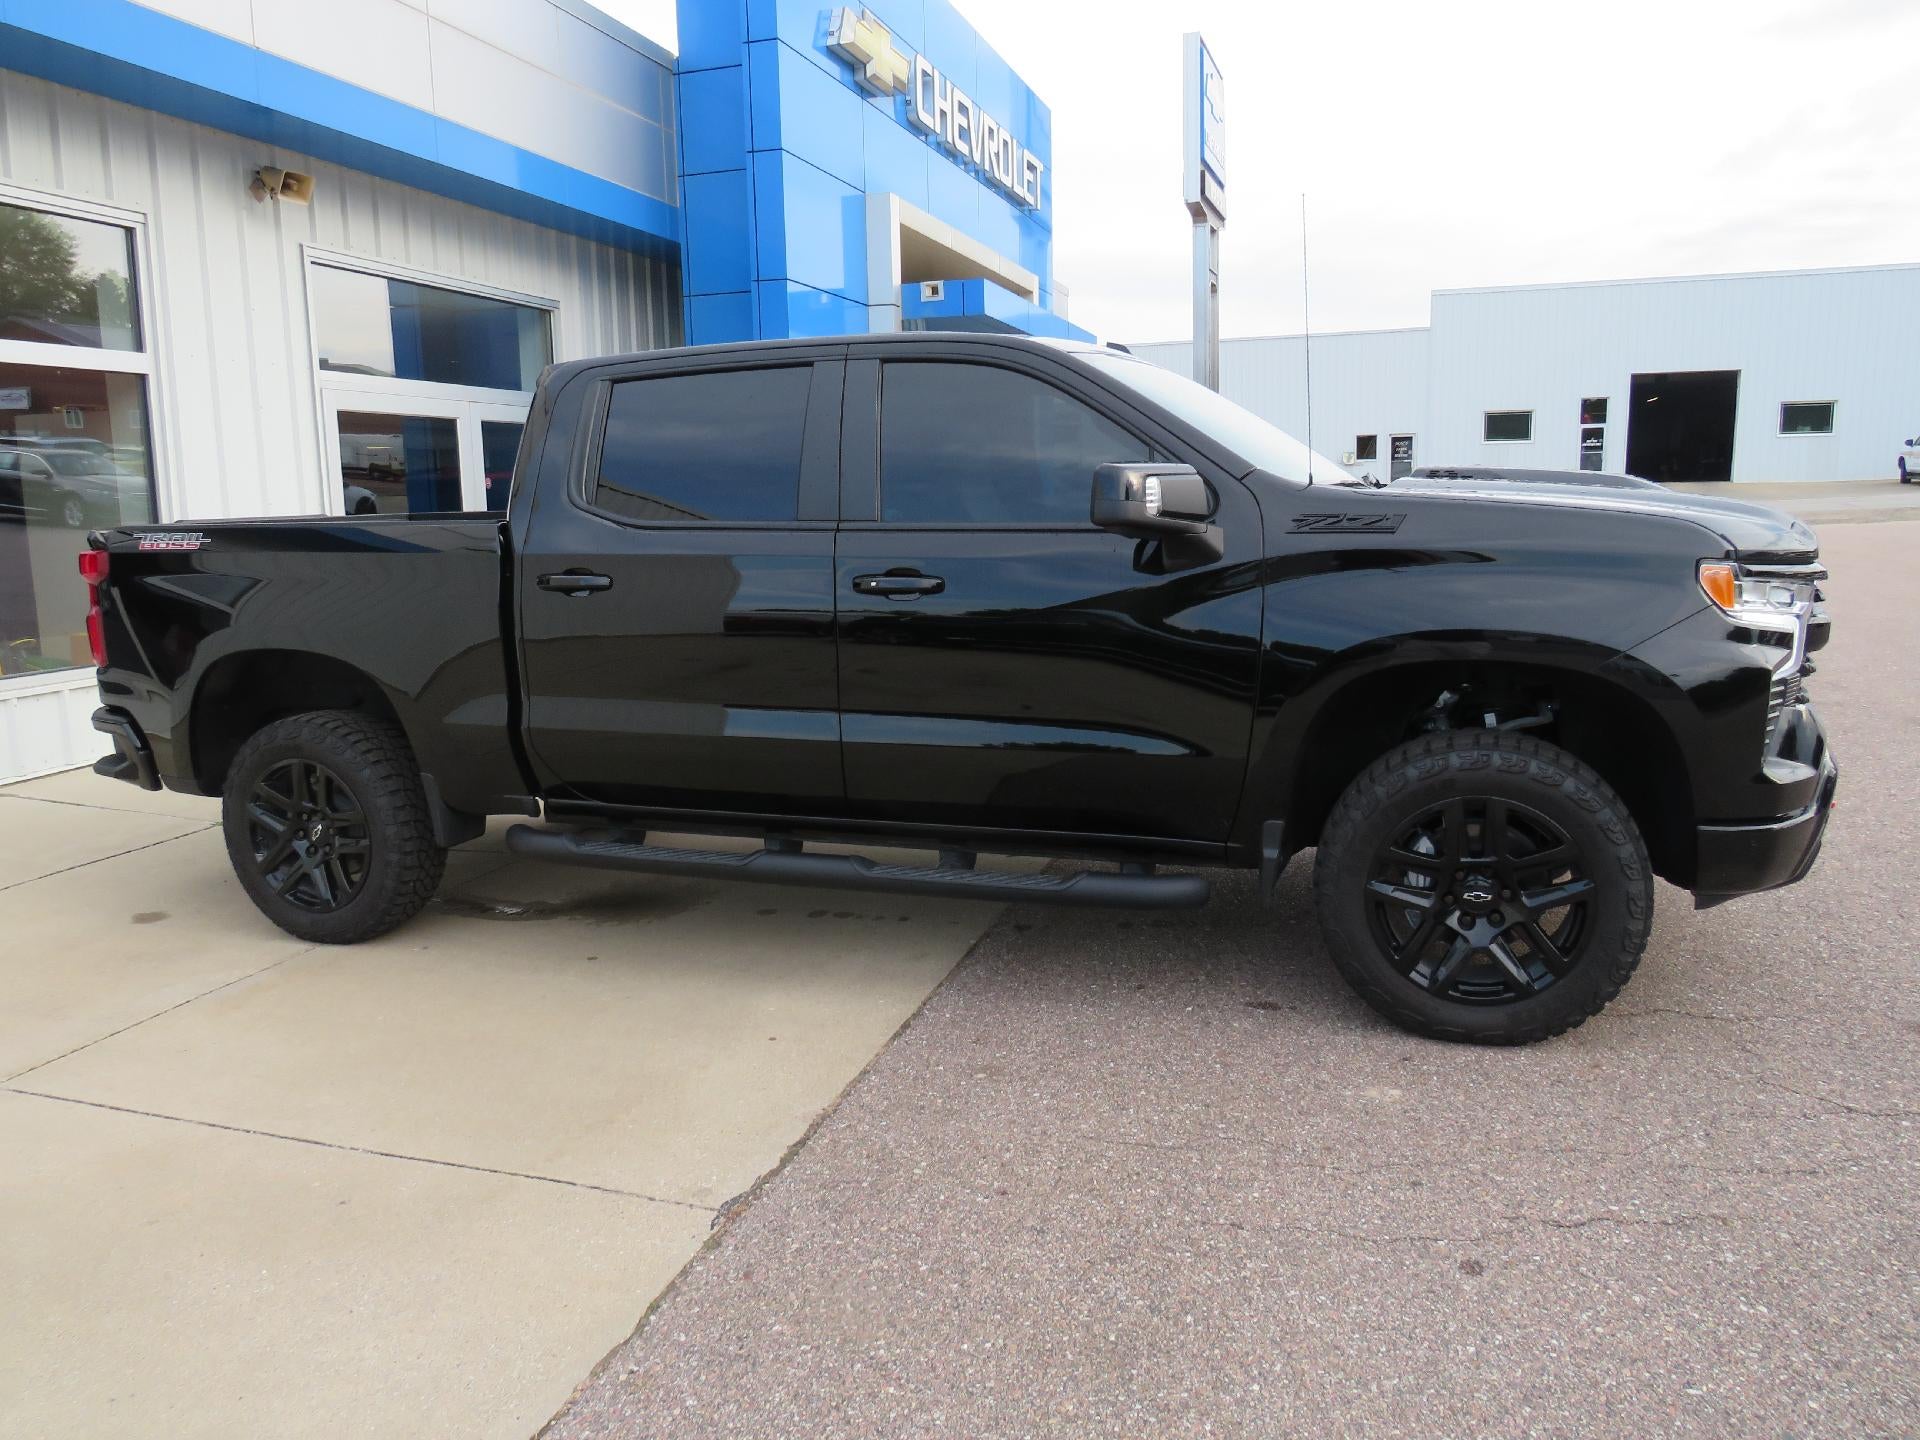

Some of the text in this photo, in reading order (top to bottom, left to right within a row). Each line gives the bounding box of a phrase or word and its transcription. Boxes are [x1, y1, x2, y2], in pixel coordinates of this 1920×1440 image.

[910, 53, 1043, 211] CHEVROLET
[133, 533, 211, 542] TRAIL
[139, 541, 200, 550] BOSS
